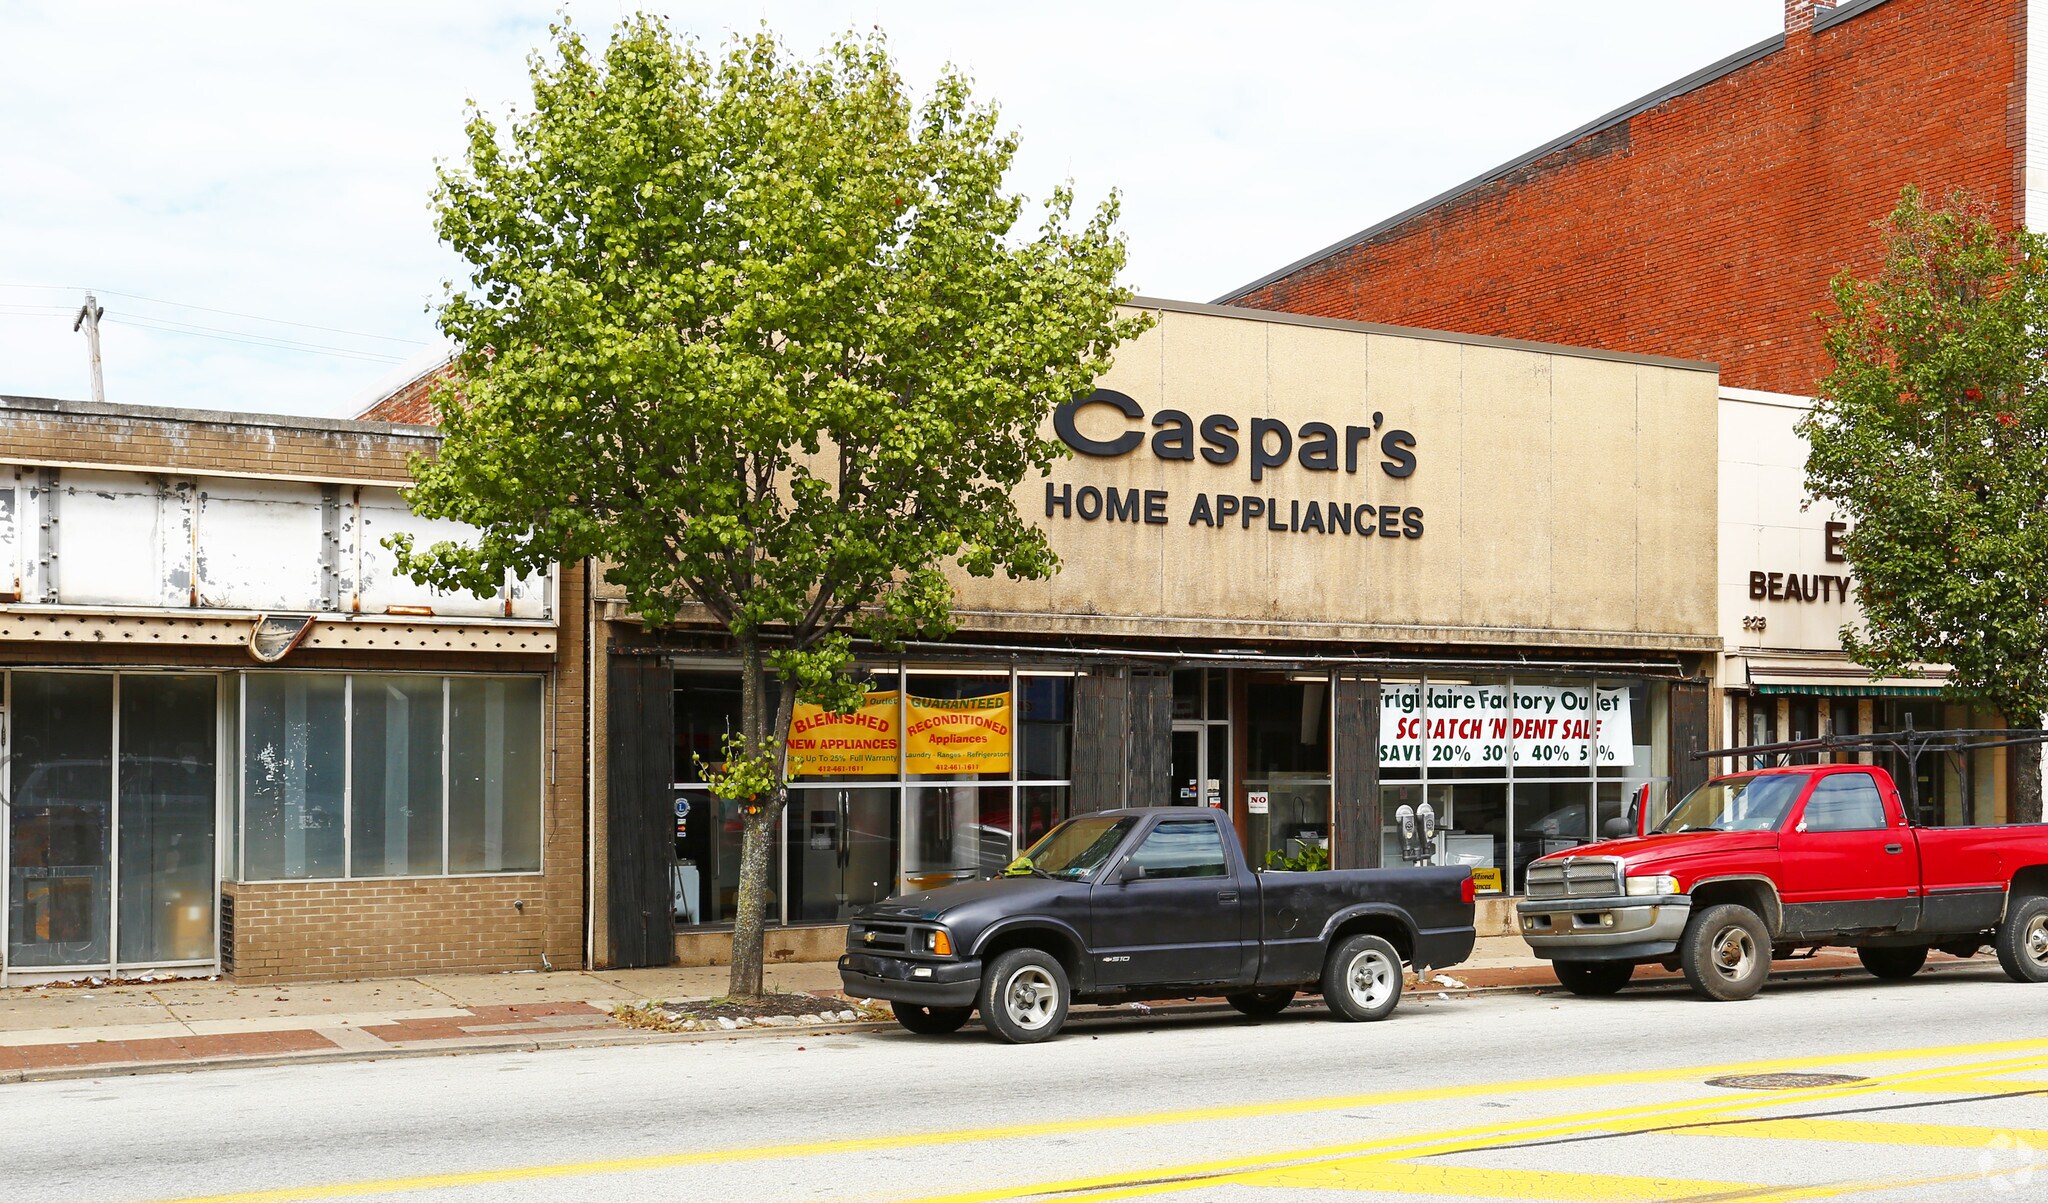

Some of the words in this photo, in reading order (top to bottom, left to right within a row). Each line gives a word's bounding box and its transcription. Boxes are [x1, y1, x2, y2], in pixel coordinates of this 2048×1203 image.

[1054, 388, 1417, 480] Caspar's
[1046, 483, 1168, 524] HOME
[1190, 492, 1424, 539] APPLIANCES
[1750, 570, 1850, 603] BEAUTY
[911, 697, 1004, 709] GUARANTEED
[1561, 691, 1620, 711] Oulet
[794, 712, 889, 734] BLEMISHED
[907, 714, 1008, 736] RECONDITIONED
[1512, 718, 1558, 739] DENT
[786, 739, 816, 749] NEW
[820, 739, 897, 749] APPLIANCES
[929, 734, 988, 745] Appliances
[1432, 745, 1471, 761] 20%
[1532, 745, 1569, 761] 40%
[1580, 745, 1614, 761] 5%
